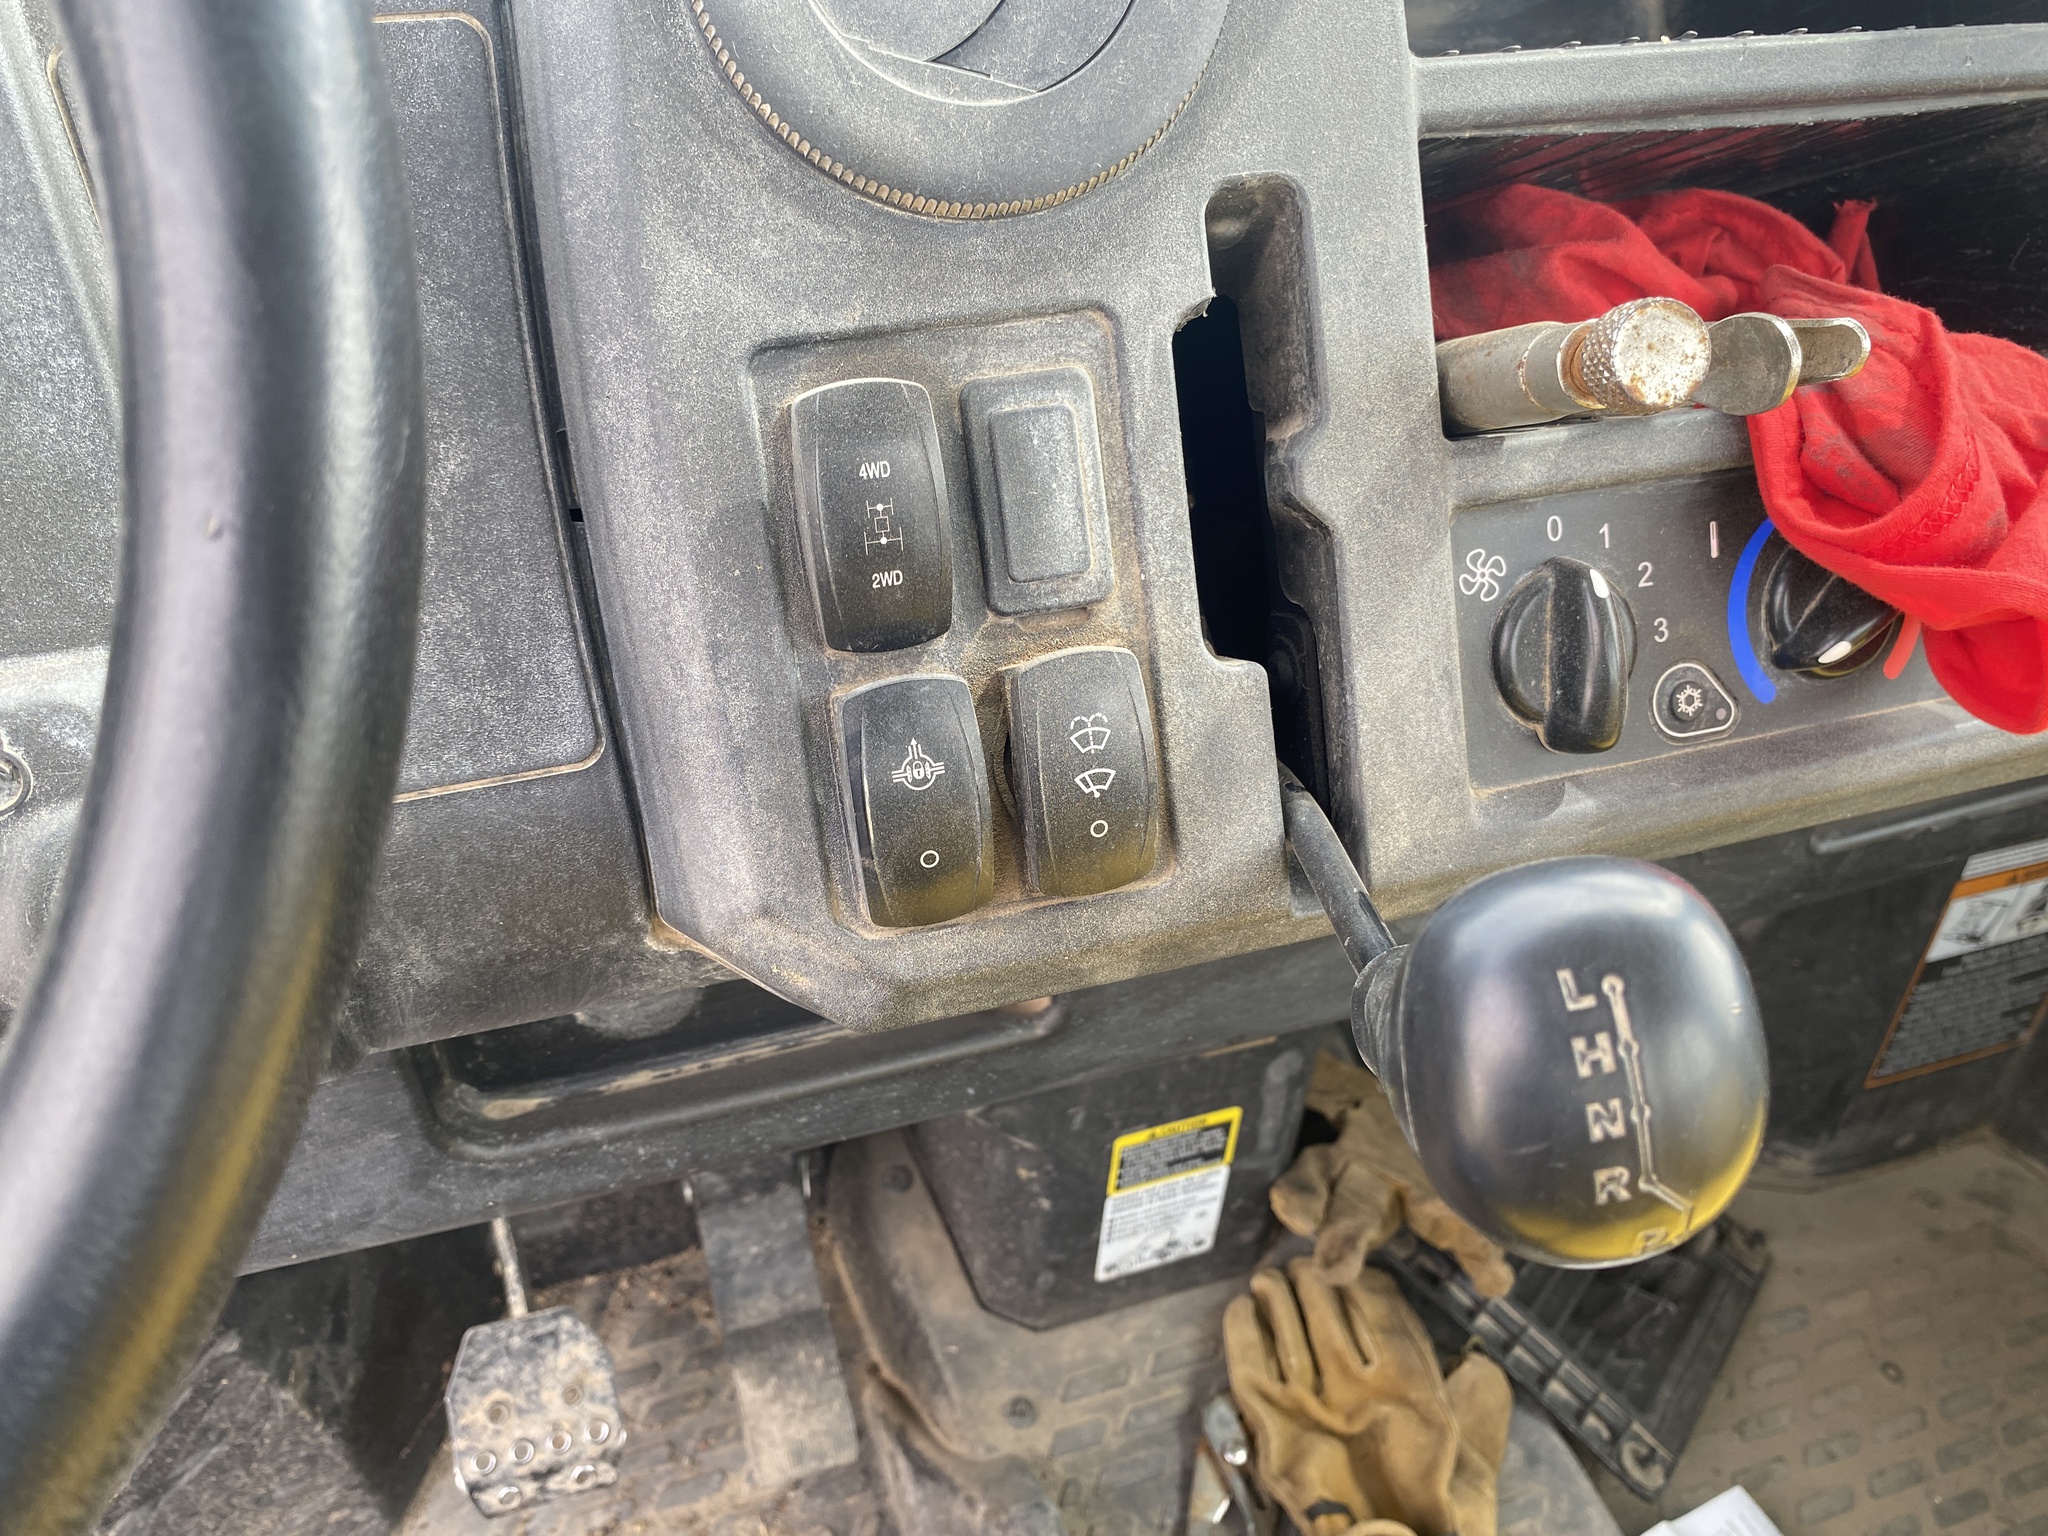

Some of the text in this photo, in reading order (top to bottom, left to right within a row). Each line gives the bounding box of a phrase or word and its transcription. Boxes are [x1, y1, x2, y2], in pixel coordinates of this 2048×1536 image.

[859, 460, 891, 480] 4WD
[1546, 515, 1563, 542] 0
[1598, 522, 1611, 549] 1
[871, 569, 903, 589] 2WD
[1637, 561, 1654, 588] 2
[1653, 617, 1670, 643] 3
[1556, 967, 1598, 1012] L
[1570, 1031, 1617, 1079] H
[1585, 1098, 1627, 1143] N
[1593, 1165, 1632, 1206] R
[1630, 1226, 1668, 1257] P
